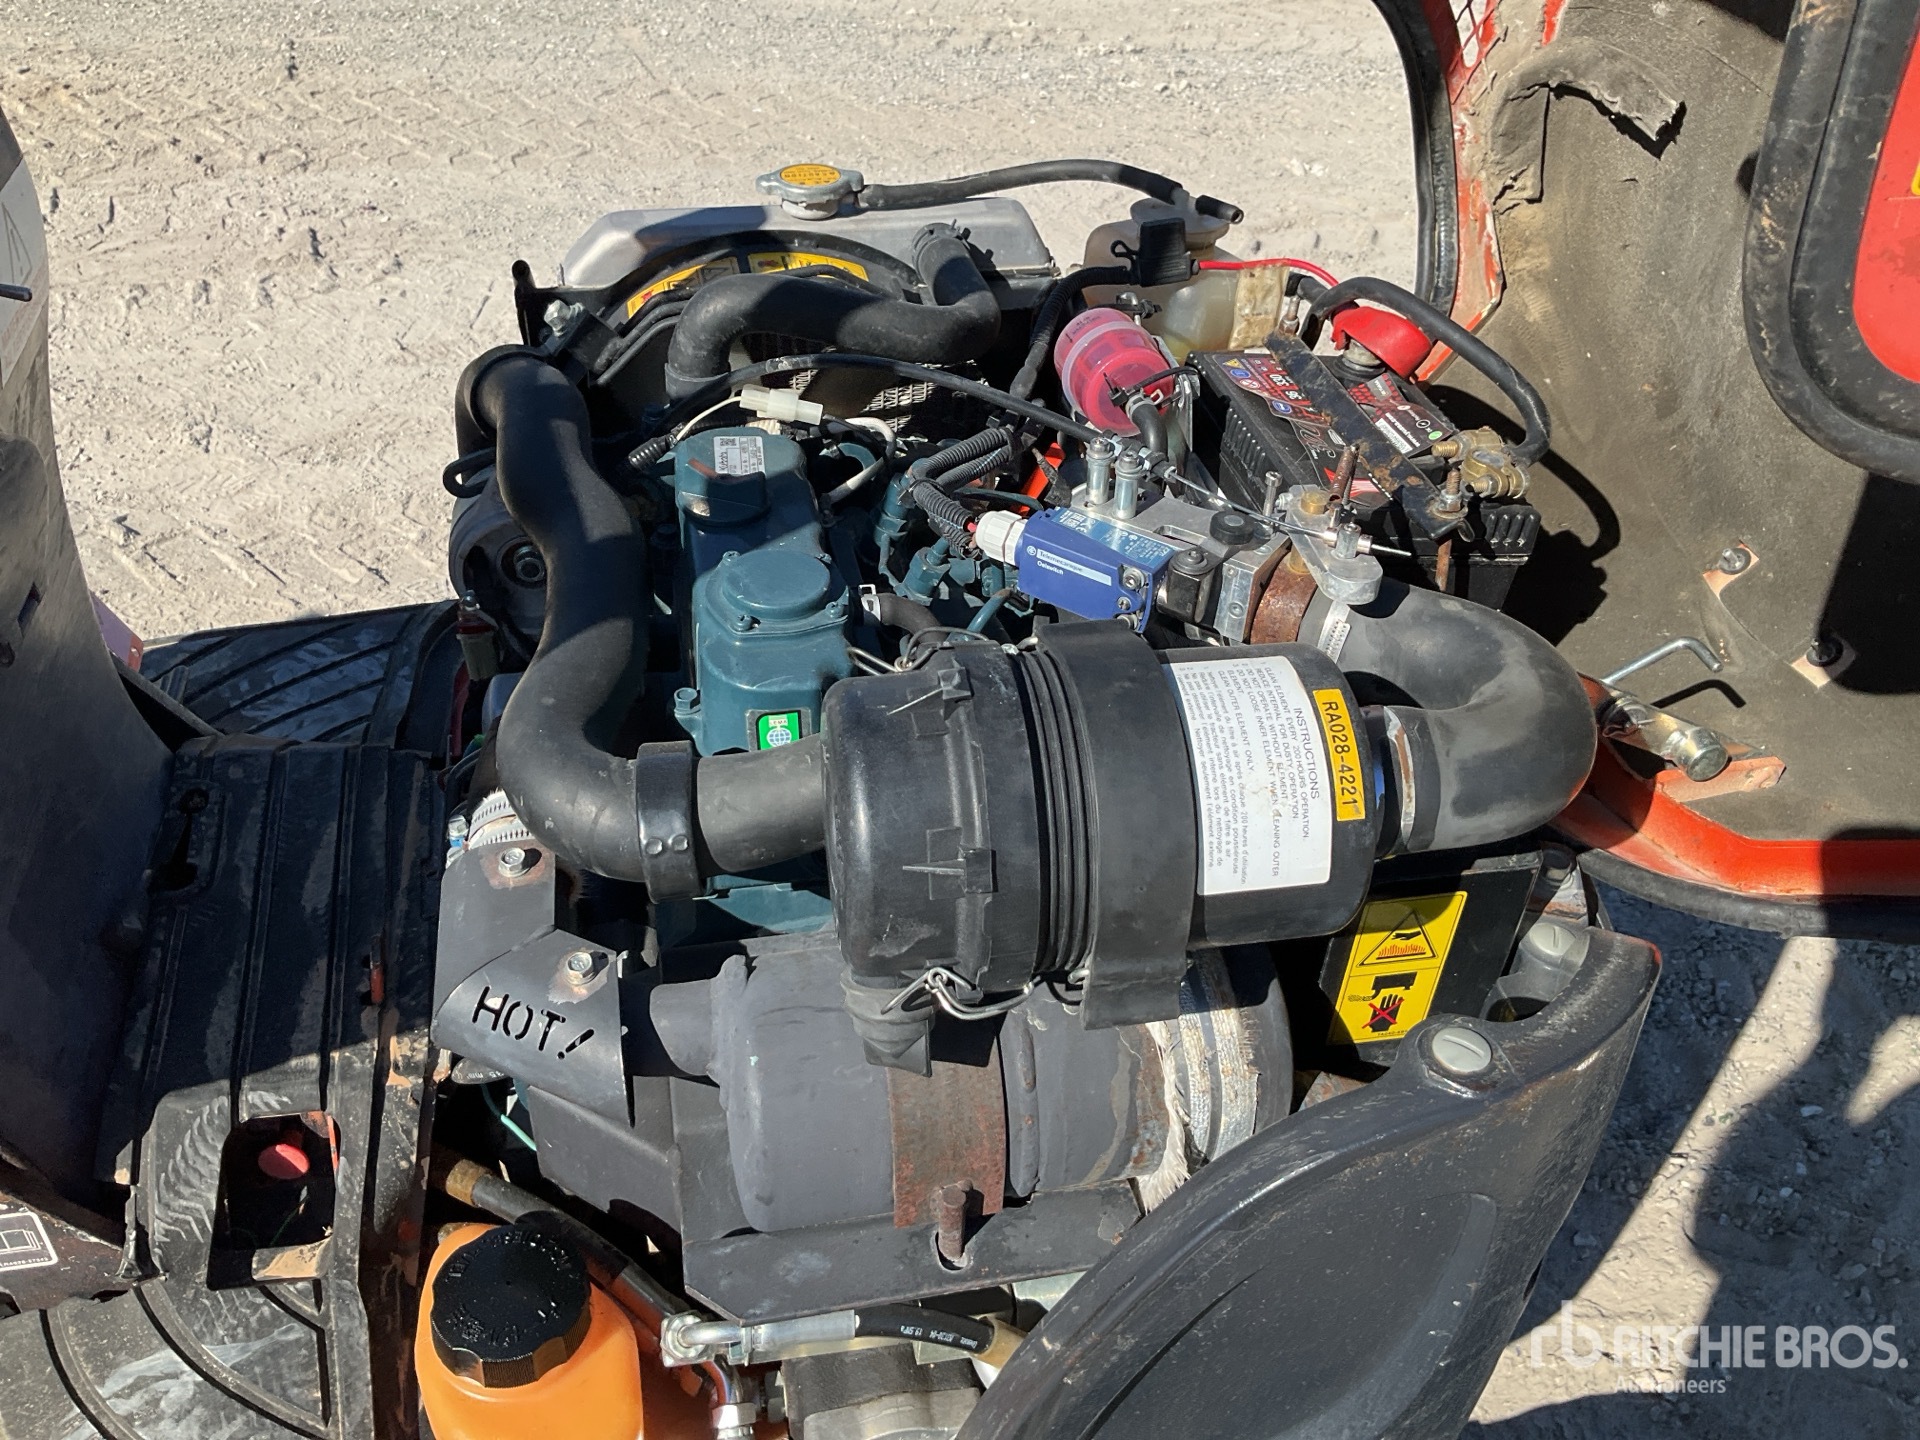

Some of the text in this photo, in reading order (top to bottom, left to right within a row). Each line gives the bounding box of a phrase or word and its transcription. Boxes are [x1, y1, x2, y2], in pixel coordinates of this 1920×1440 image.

[1240, 677, 1251, 690] NOT
[1254, 667, 1270, 688] REDUCE
[1263, 666, 1277, 684] CLEAN
[1245, 690, 1261, 713] LOOSE
[1265, 689, 1283, 721] INTERVAL
[1272, 684, 1291, 714] ELEMENT
[1217, 724, 1226, 734] de
[1226, 688, 1241, 710] OUTER
[1234, 712, 1251, 747] ELEMENT
[1249, 676, 1261, 689] NOT
[1255, 690, 1273, 720] OPERATE
[1268, 723, 1282, 758] WITHOUT
[1255, 714, 1268, 737] INNER
[1277, 722, 1288, 739] FOR
[1284, 716, 1297, 741] EVERY
[1218, 735, 1235, 773] nettoyage
[1261, 739, 1276, 777] ELEMENT
[1282, 741, 1294, 768] DUSTY
[1291, 745, 1302, 761] 200
[1293, 708, 1320, 799] INSTRUCTIONS
[1321, 701, 1358, 804] RA028-4221
[1224, 715, 1234, 724] du
[1240, 810, 1249, 824] 200
[1294, 759, 1307, 788] HOURS
[1215, 751, 1225, 770] sans
[1222, 805, 1231, 817] de
[1214, 803, 1222, 814] du
[1230, 787, 1240, 824] condition
[1216, 856, 1224, 867] de
[1271, 850, 1279, 876] OUTER
[472, 986, 594, 1060] HOT!
